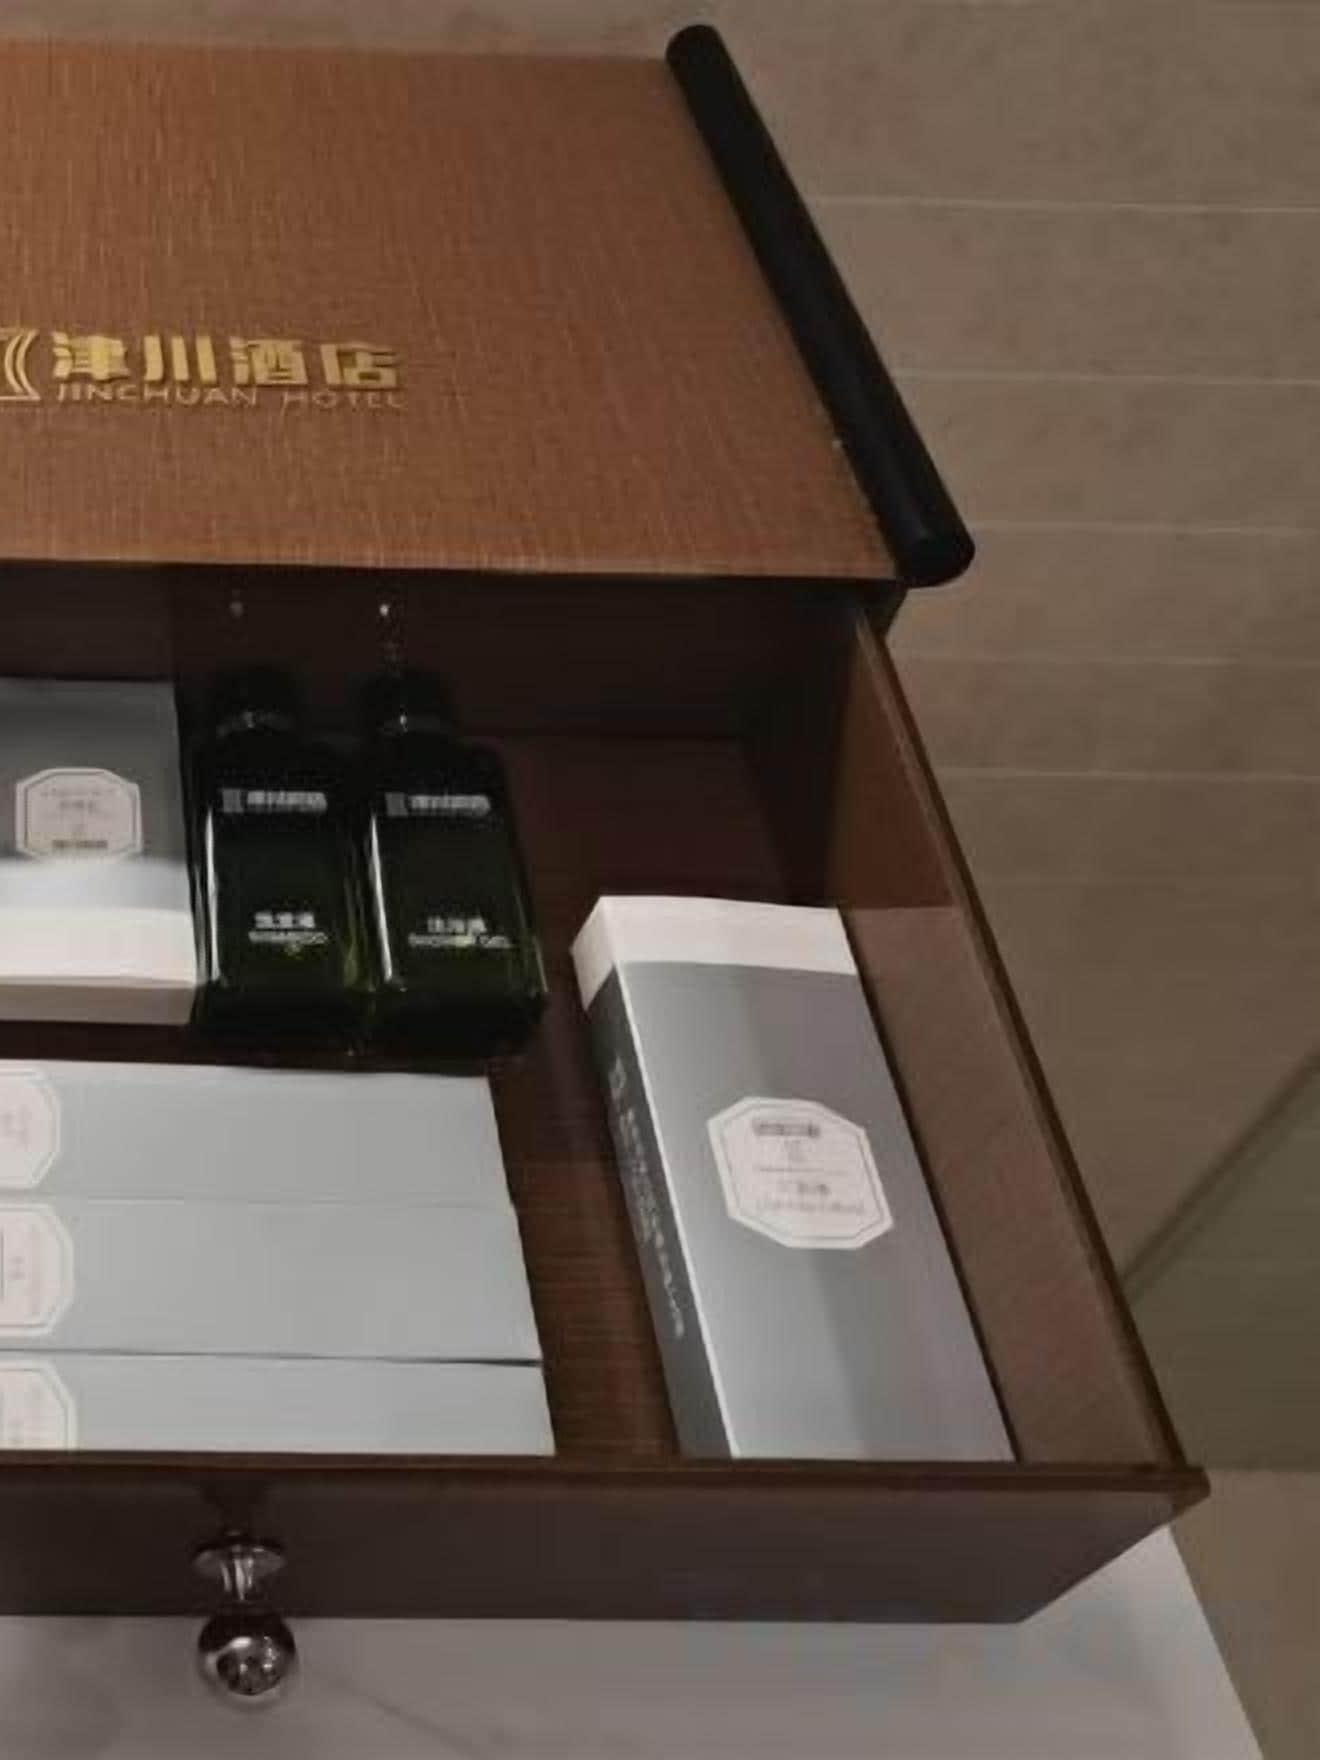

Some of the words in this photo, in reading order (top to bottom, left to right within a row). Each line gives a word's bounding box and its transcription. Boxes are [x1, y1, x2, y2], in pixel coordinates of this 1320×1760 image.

[52, 331, 398, 390] 津川酒店
[57, 382, 257, 406] JINCHUAN
[280, 390, 408, 410] HOTEL
